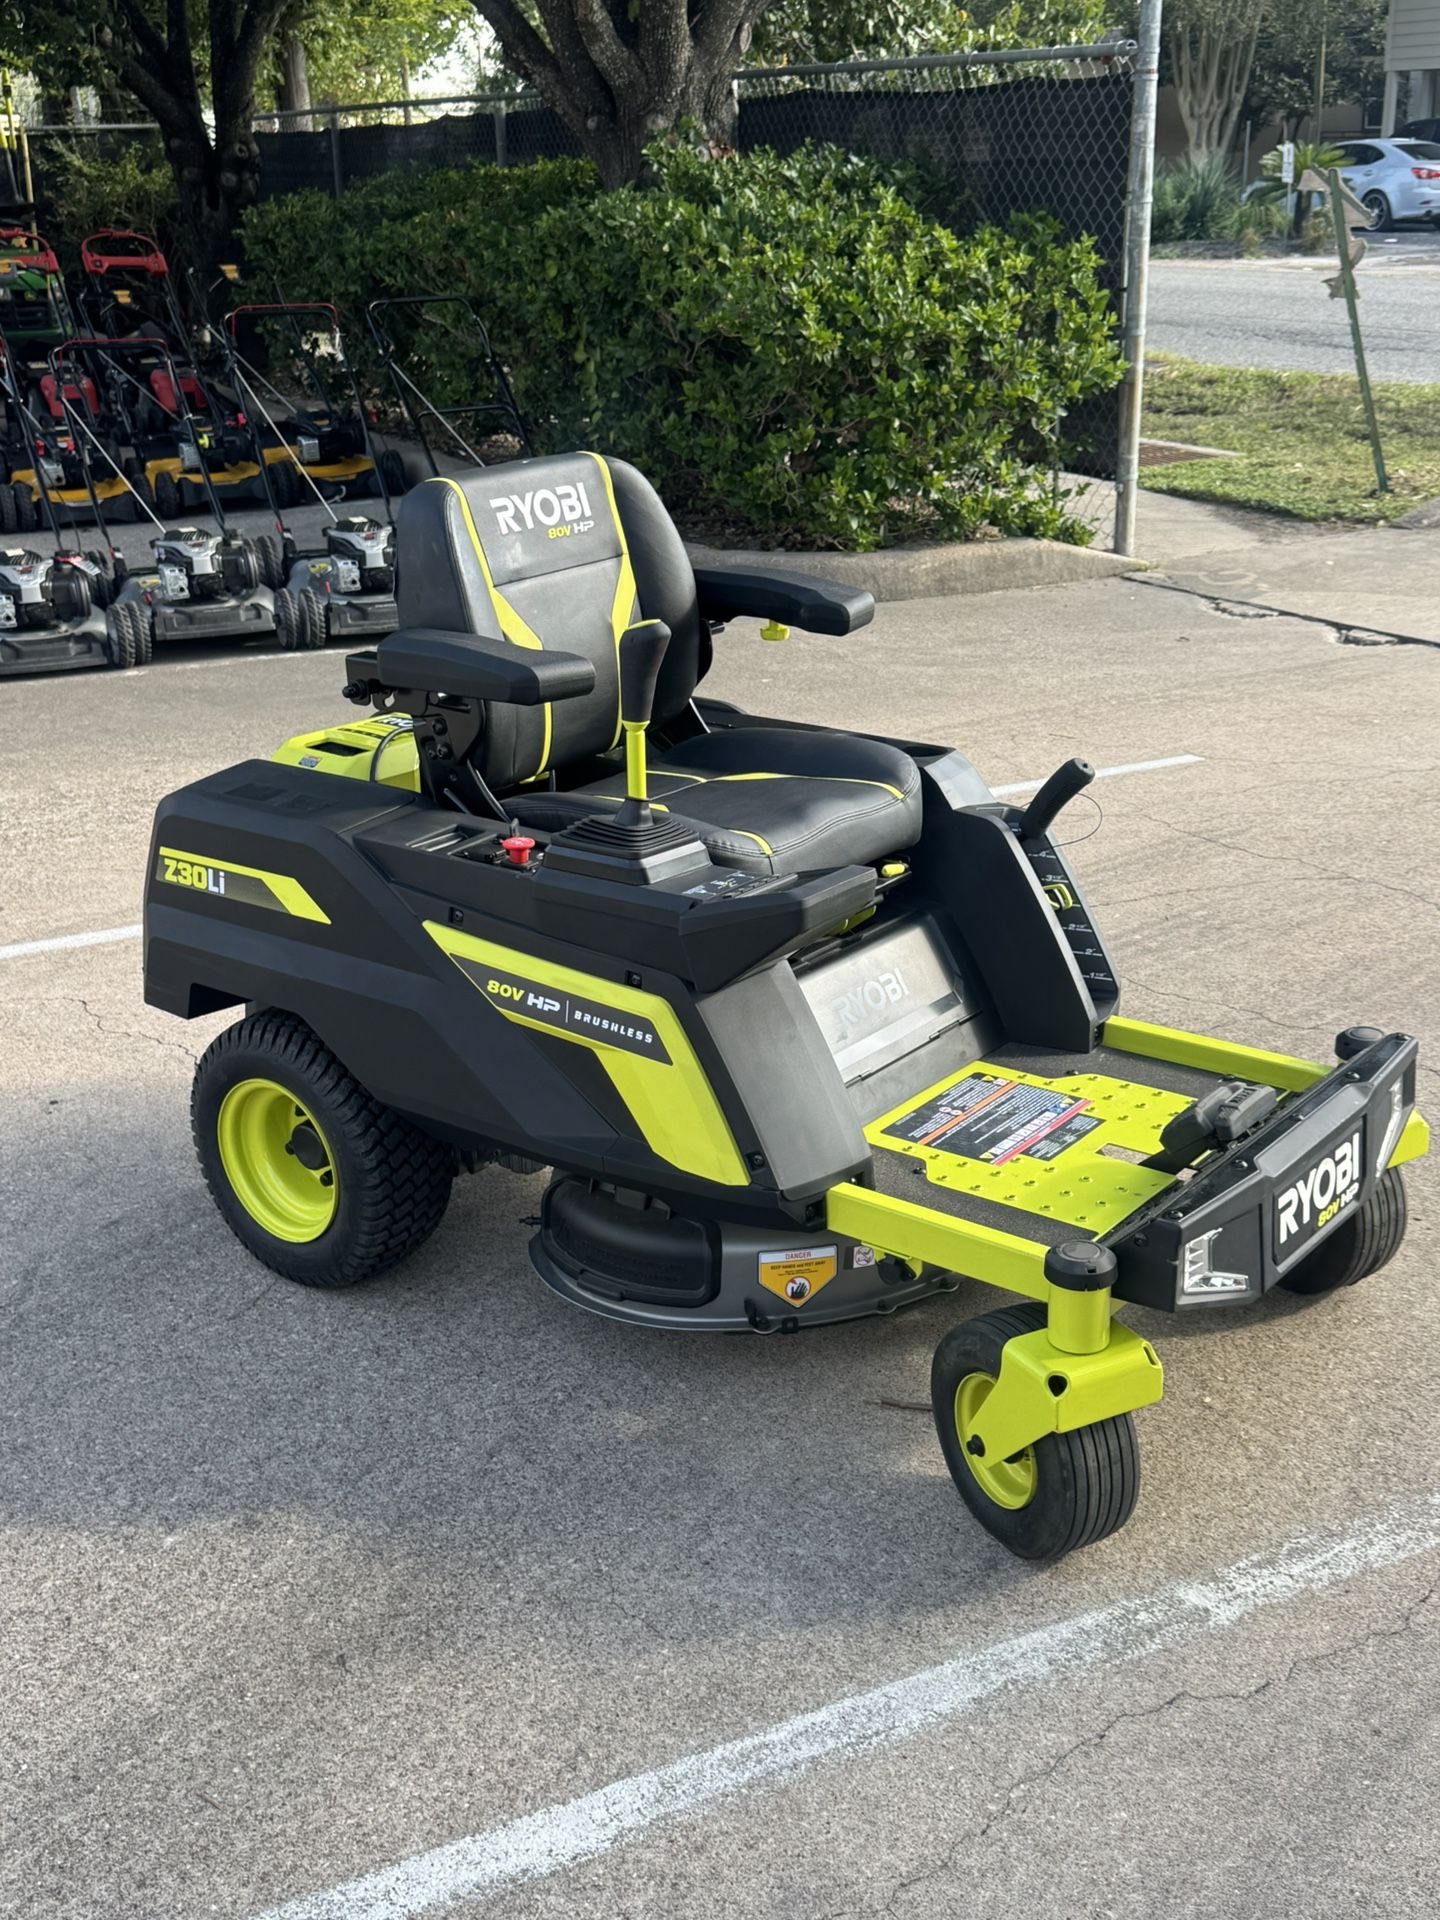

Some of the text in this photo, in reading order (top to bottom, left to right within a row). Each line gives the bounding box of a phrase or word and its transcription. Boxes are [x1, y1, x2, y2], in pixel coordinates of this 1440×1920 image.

[489, 482, 592, 535] RYOBI
[547, 520, 595, 539] 80V HP
[163, 858, 225, 895] Z30Li
[486, 979, 653, 1044] 80V HP BRUSHLESS
[831, 967, 910, 1026] RYOBI
[1278, 1132, 1360, 1244] RYOBI
[1318, 1182, 1359, 1227] 80V HP
[785, 1251, 812, 1260] DANGER
